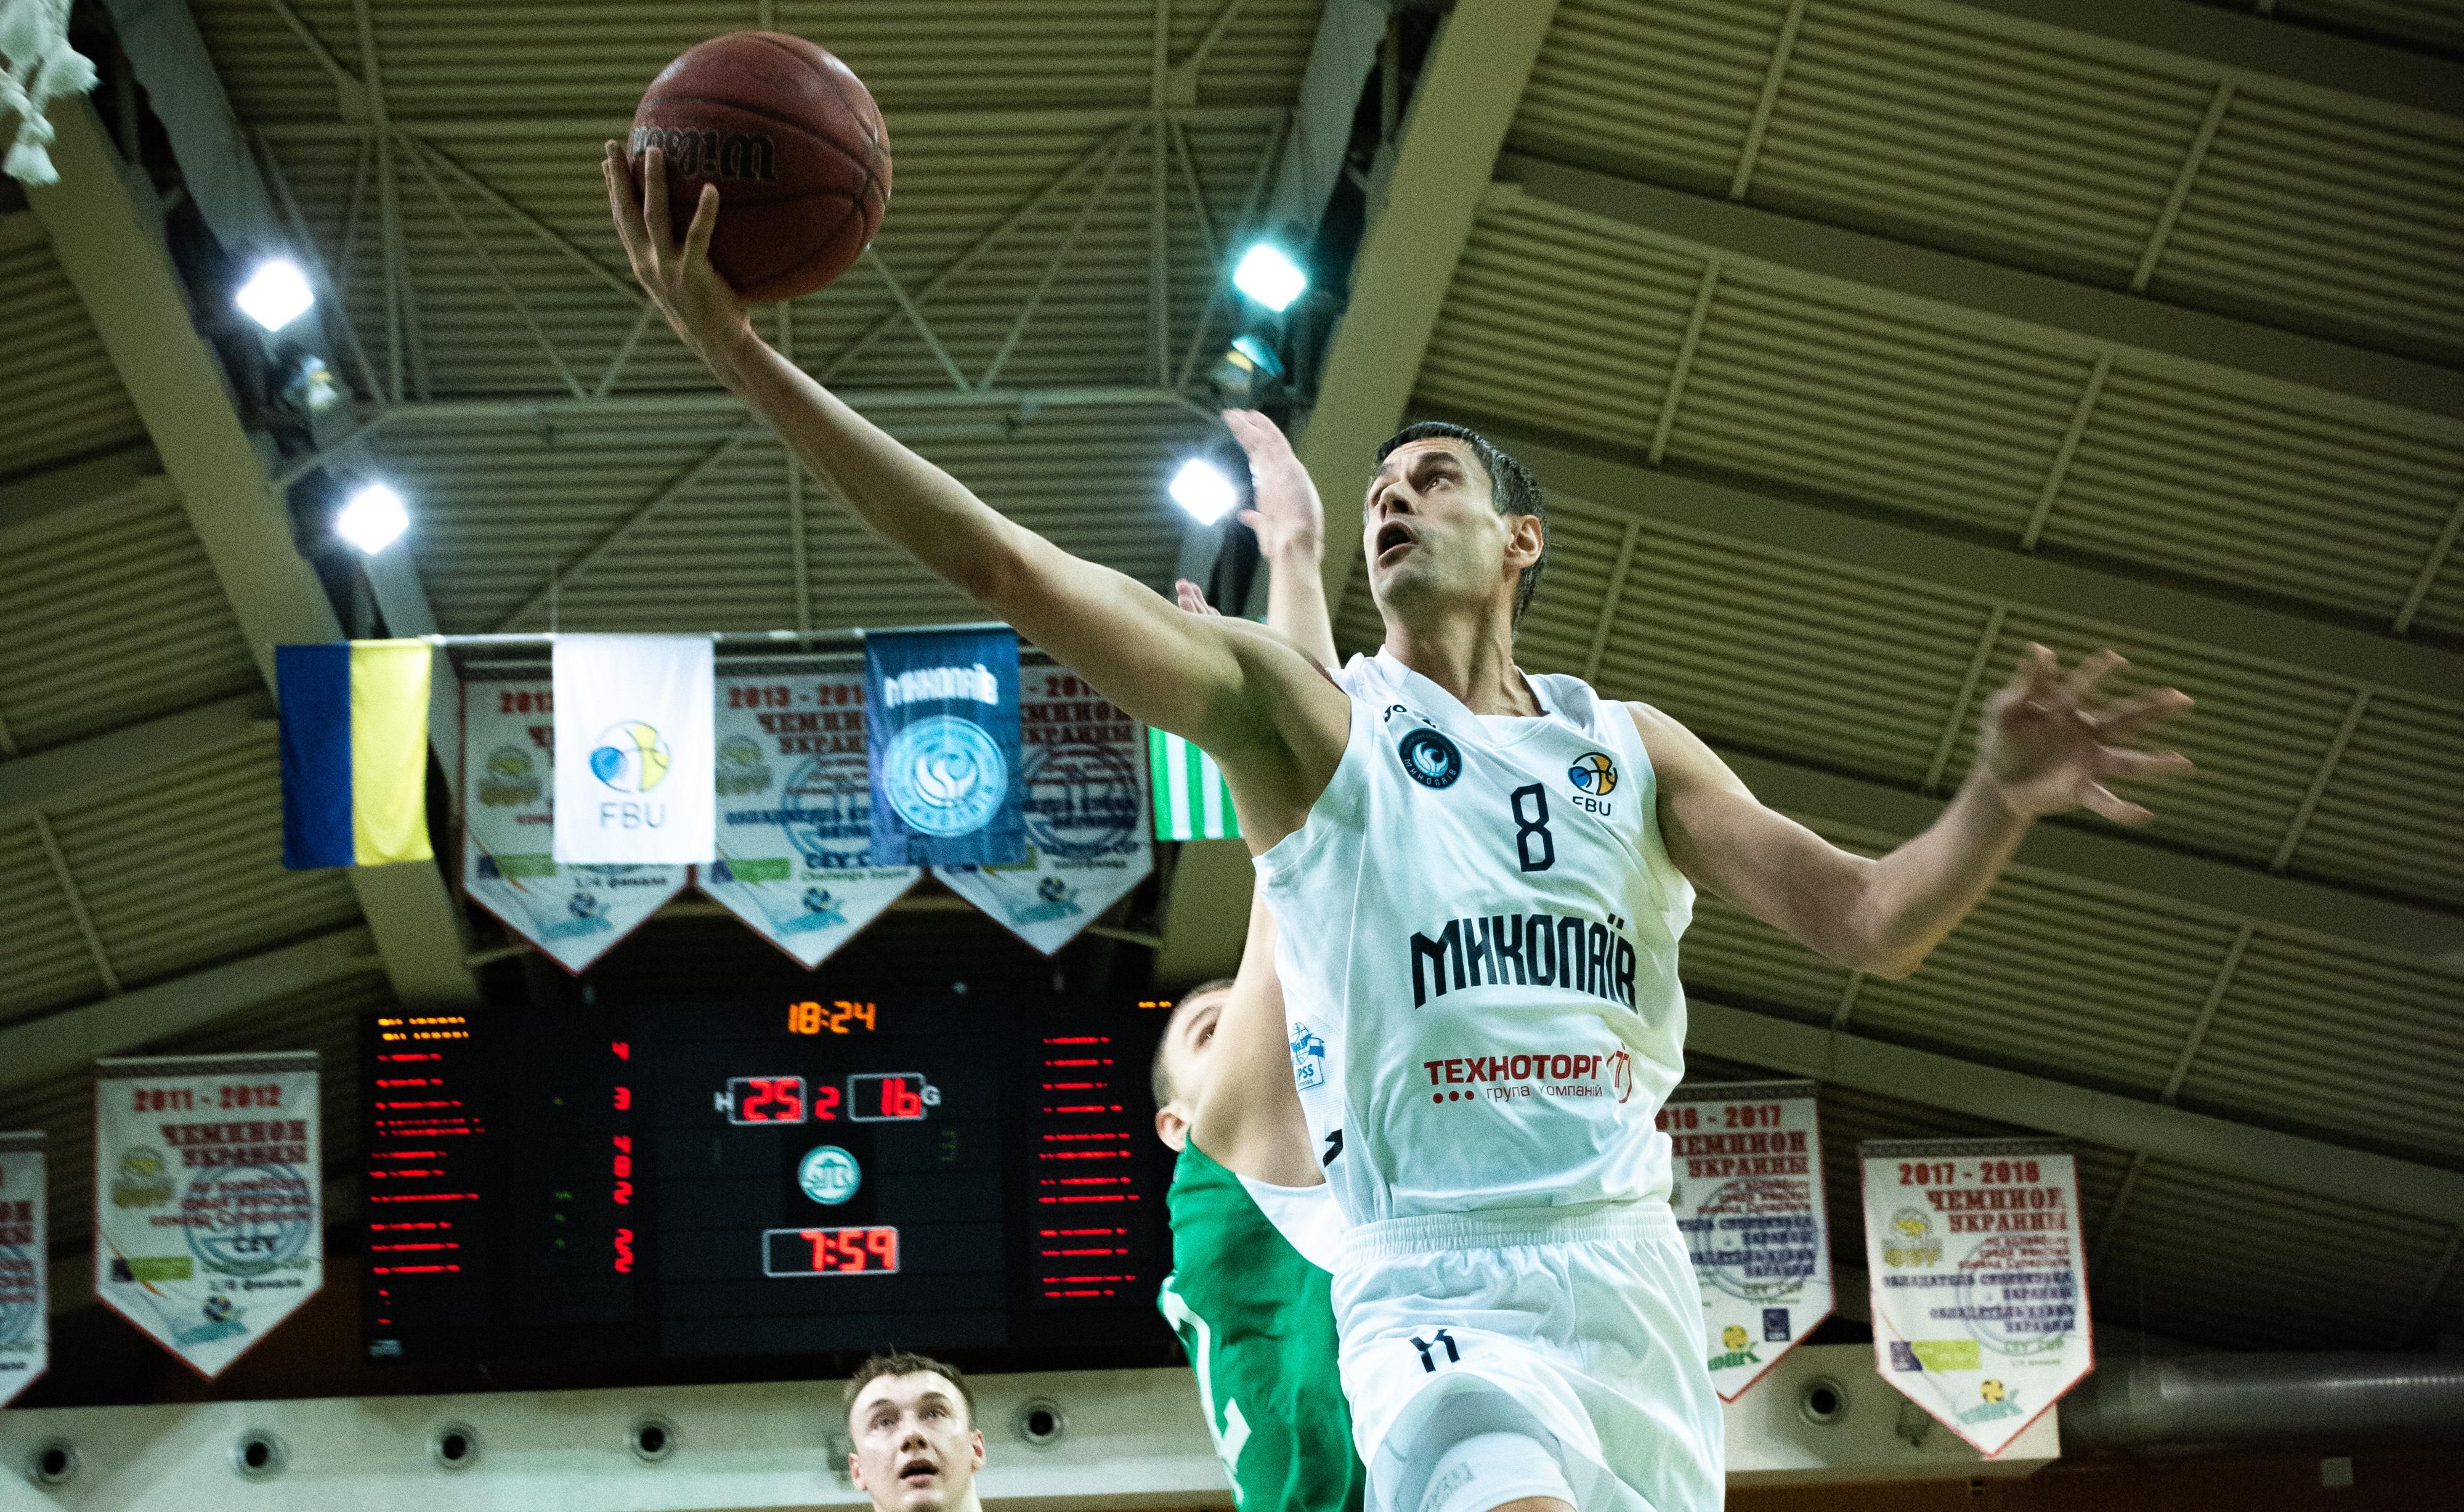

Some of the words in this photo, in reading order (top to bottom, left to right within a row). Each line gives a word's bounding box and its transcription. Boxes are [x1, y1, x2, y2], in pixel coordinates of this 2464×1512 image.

[729, 685, 790, 709] 2013
[818, 683, 865, 706] 201
[1045, 675, 1100, 697] 201
[599, 802, 666, 829] FBU
[1573, 796, 1611, 816] FBU
[1510, 782, 1555, 872] 8
[787, 1001, 877, 1035] 18:24
[1424, 1054, 1602, 1086] ТЕХНОТОРГ
[134, 1087, 193, 1112] 2011
[220, 1084, 282, 1109] 2012
[714, 1091, 735, 1112] H
[743, 1078, 801, 1121] 25
[814, 1086, 840, 1121] 2
[881, 1077, 922, 1117] 16
[922, 1084, 942, 1106] G
[1486, 1085, 1530, 1103] група
[1654, 1107, 1699, 1131] 016
[1725, 1105, 1781, 1128] 2017
[1899, 1163, 1955, 1185] 2017
[1980, 1161, 2040, 1184] 2018
[801, 1229, 896, 1272] 7:59
